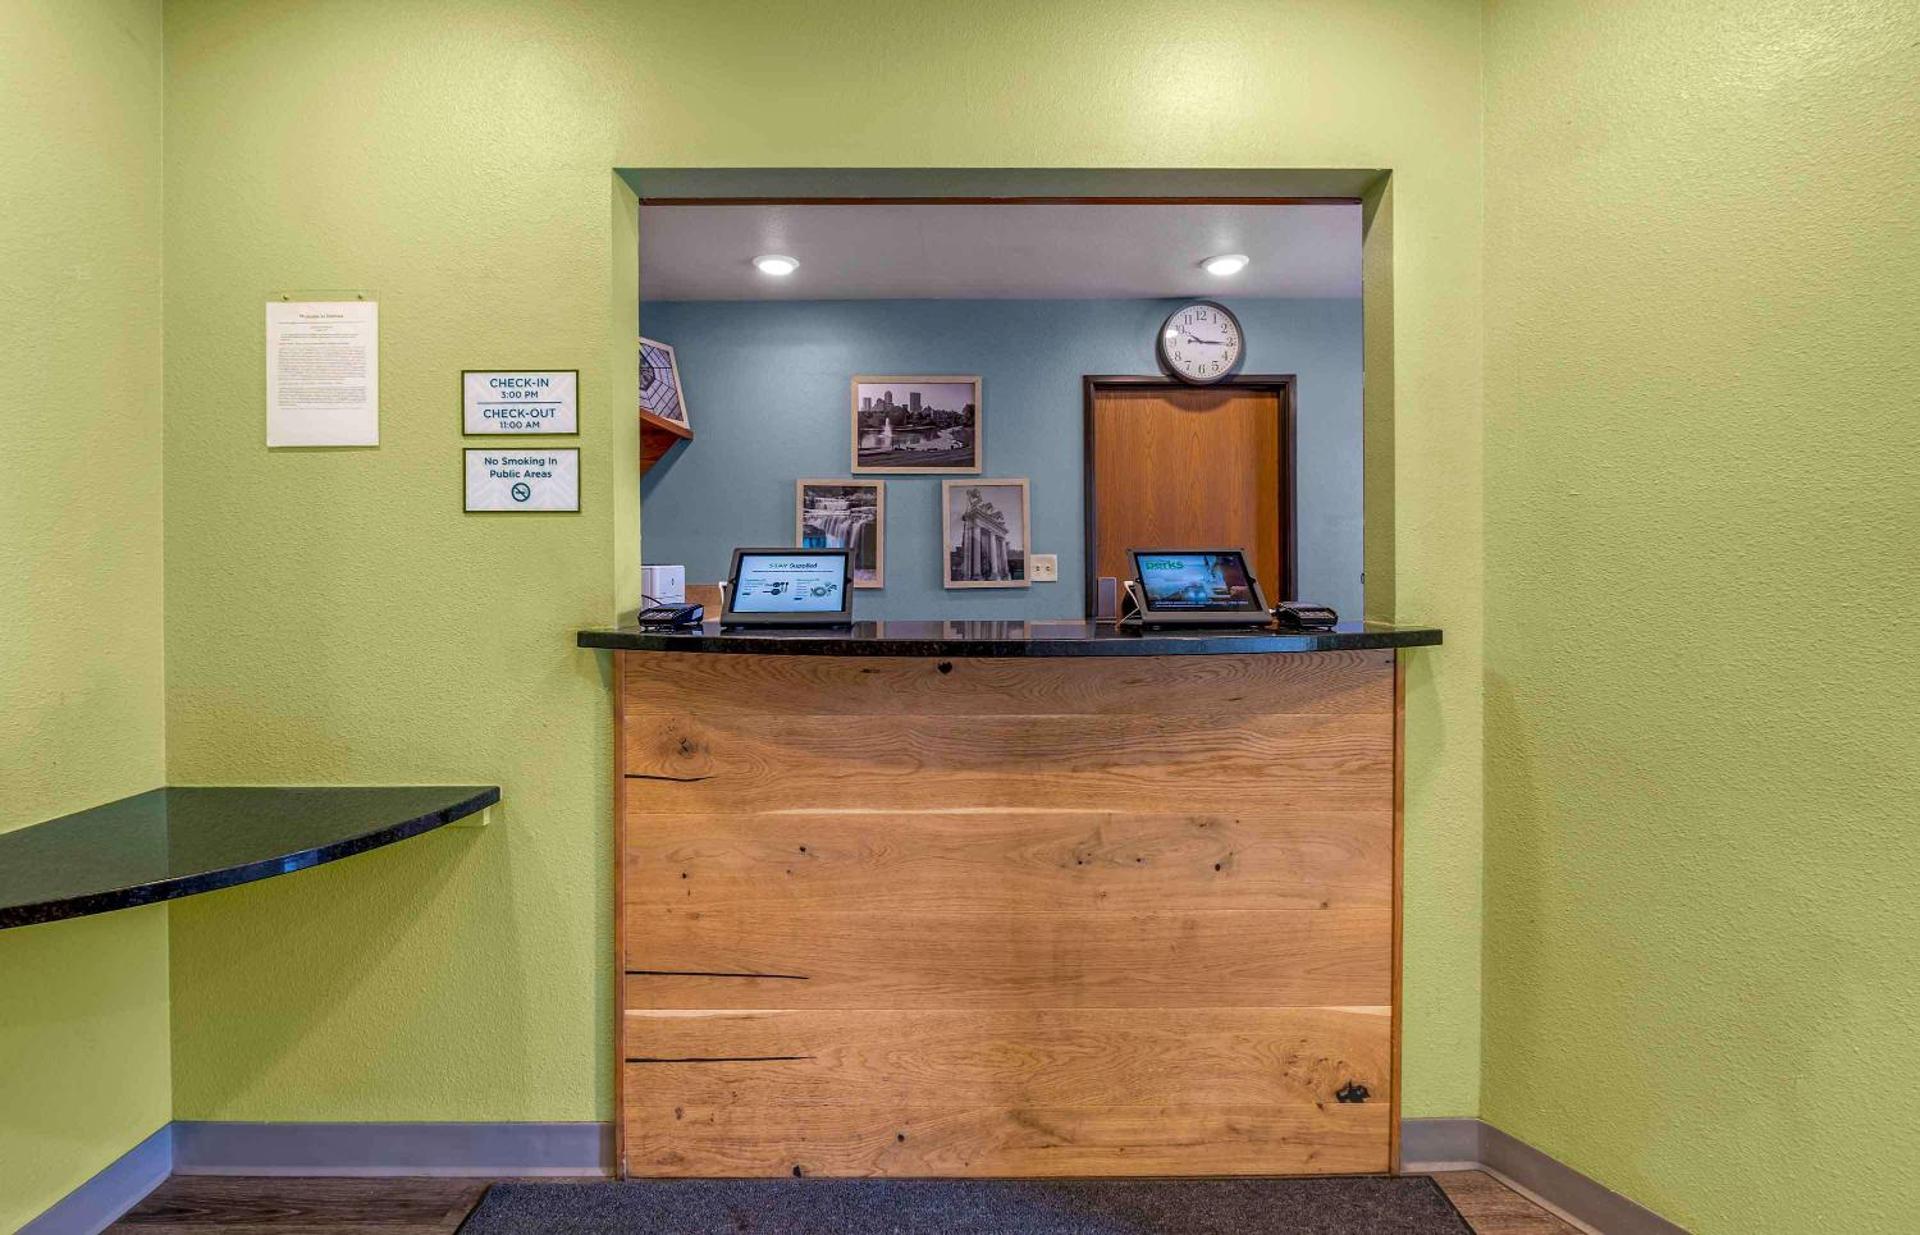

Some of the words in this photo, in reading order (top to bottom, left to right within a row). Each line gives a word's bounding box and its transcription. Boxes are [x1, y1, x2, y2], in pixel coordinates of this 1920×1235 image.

[1184, 315, 1192, 325] 11
[1196, 311, 1207, 320] 12
[1213, 313, 1217, 324] 1
[1221, 323, 1228, 334] 2
[1226, 337, 1234, 347] 3
[1174, 351, 1181, 361] 8
[1221, 351, 1228, 361] 4
[1184, 360, 1192, 371] 7
[1198, 364, 1206, 374] 6
[1211, 360, 1219, 371] 5
[490, 378, 549, 388] CHECK-IN
[501, 391, 522, 399] 3:00
[483, 408, 556, 419] CHECK-OUT
[499, 421, 523, 429] 11:00
[525, 421, 540, 429] AM
[484, 457, 499, 466] No
[501, 457, 545, 466] Smoking
[548, 457, 558, 466] In
[489, 469, 521, 478] Public
[523, 470, 553, 478] Areas
